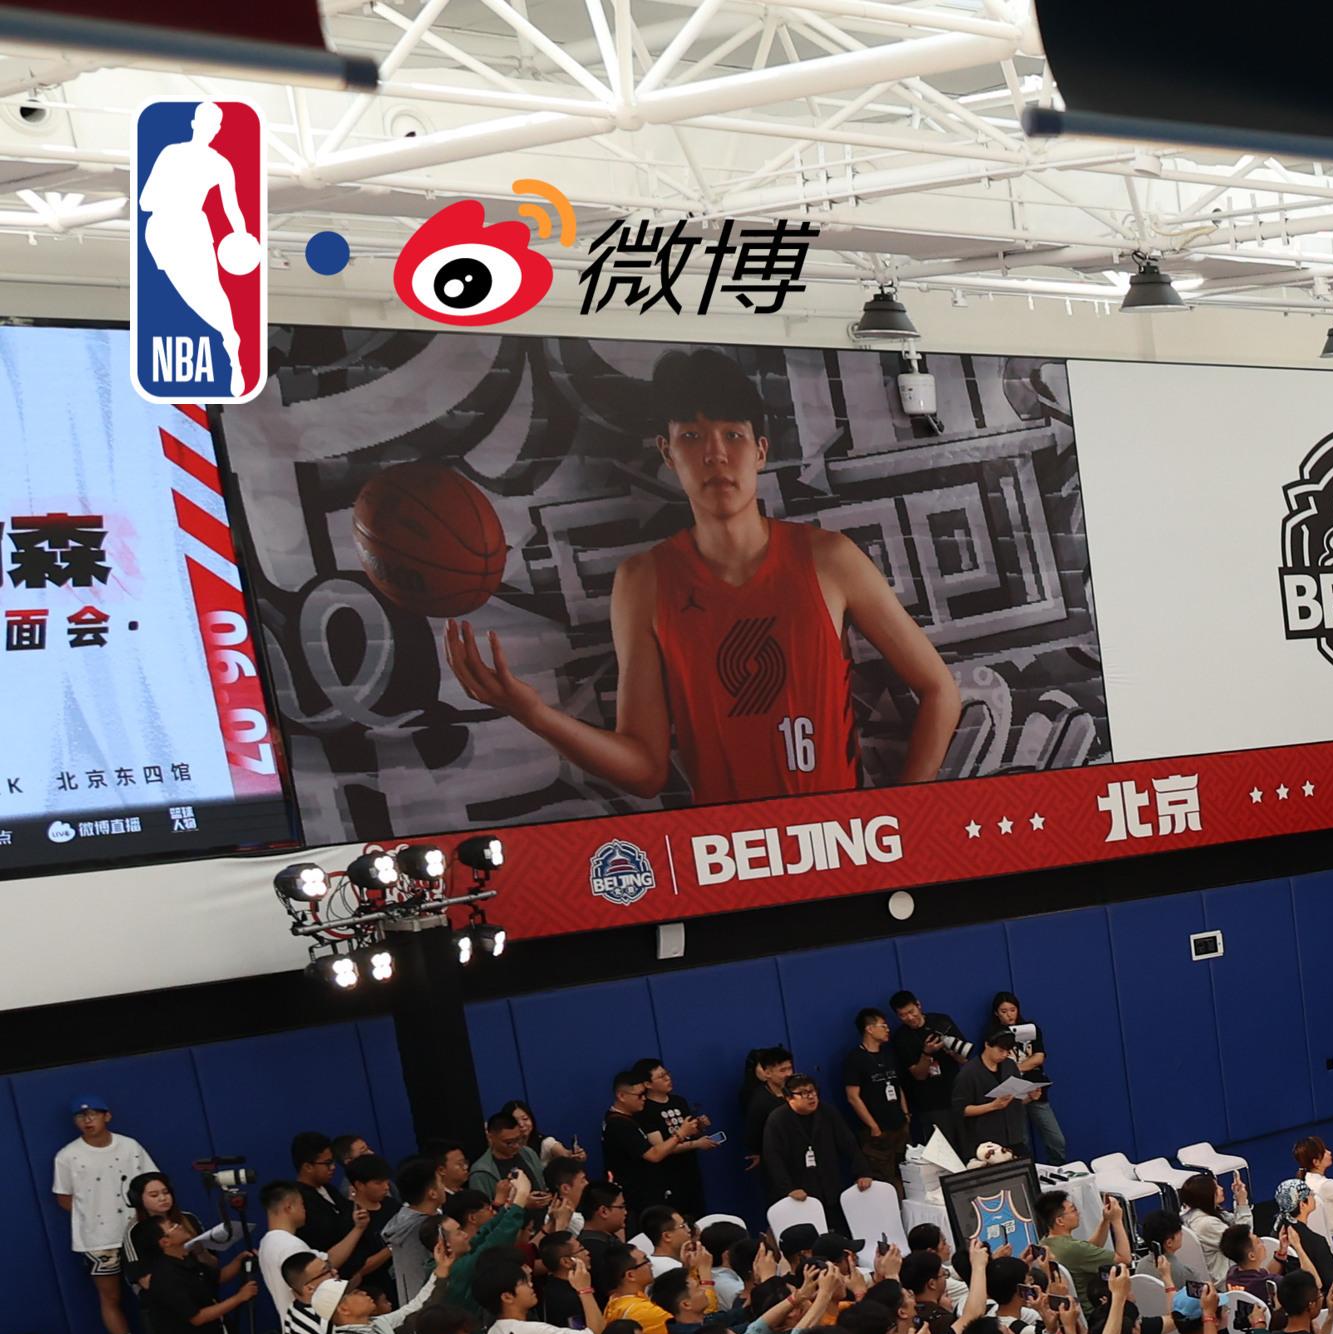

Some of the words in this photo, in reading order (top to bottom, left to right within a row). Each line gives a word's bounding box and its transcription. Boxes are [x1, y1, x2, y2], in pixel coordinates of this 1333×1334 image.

[0, 512, 112, 588] 森
[777, 715, 817, 773] 16
[56, 762, 193, 792] 北京东四馆
[79, 817, 142, 838] 微博直播
[1097, 773, 1203, 842] 北京
[691, 815, 904, 887] BEIJING
[592, 872, 654, 894] BEIJING
